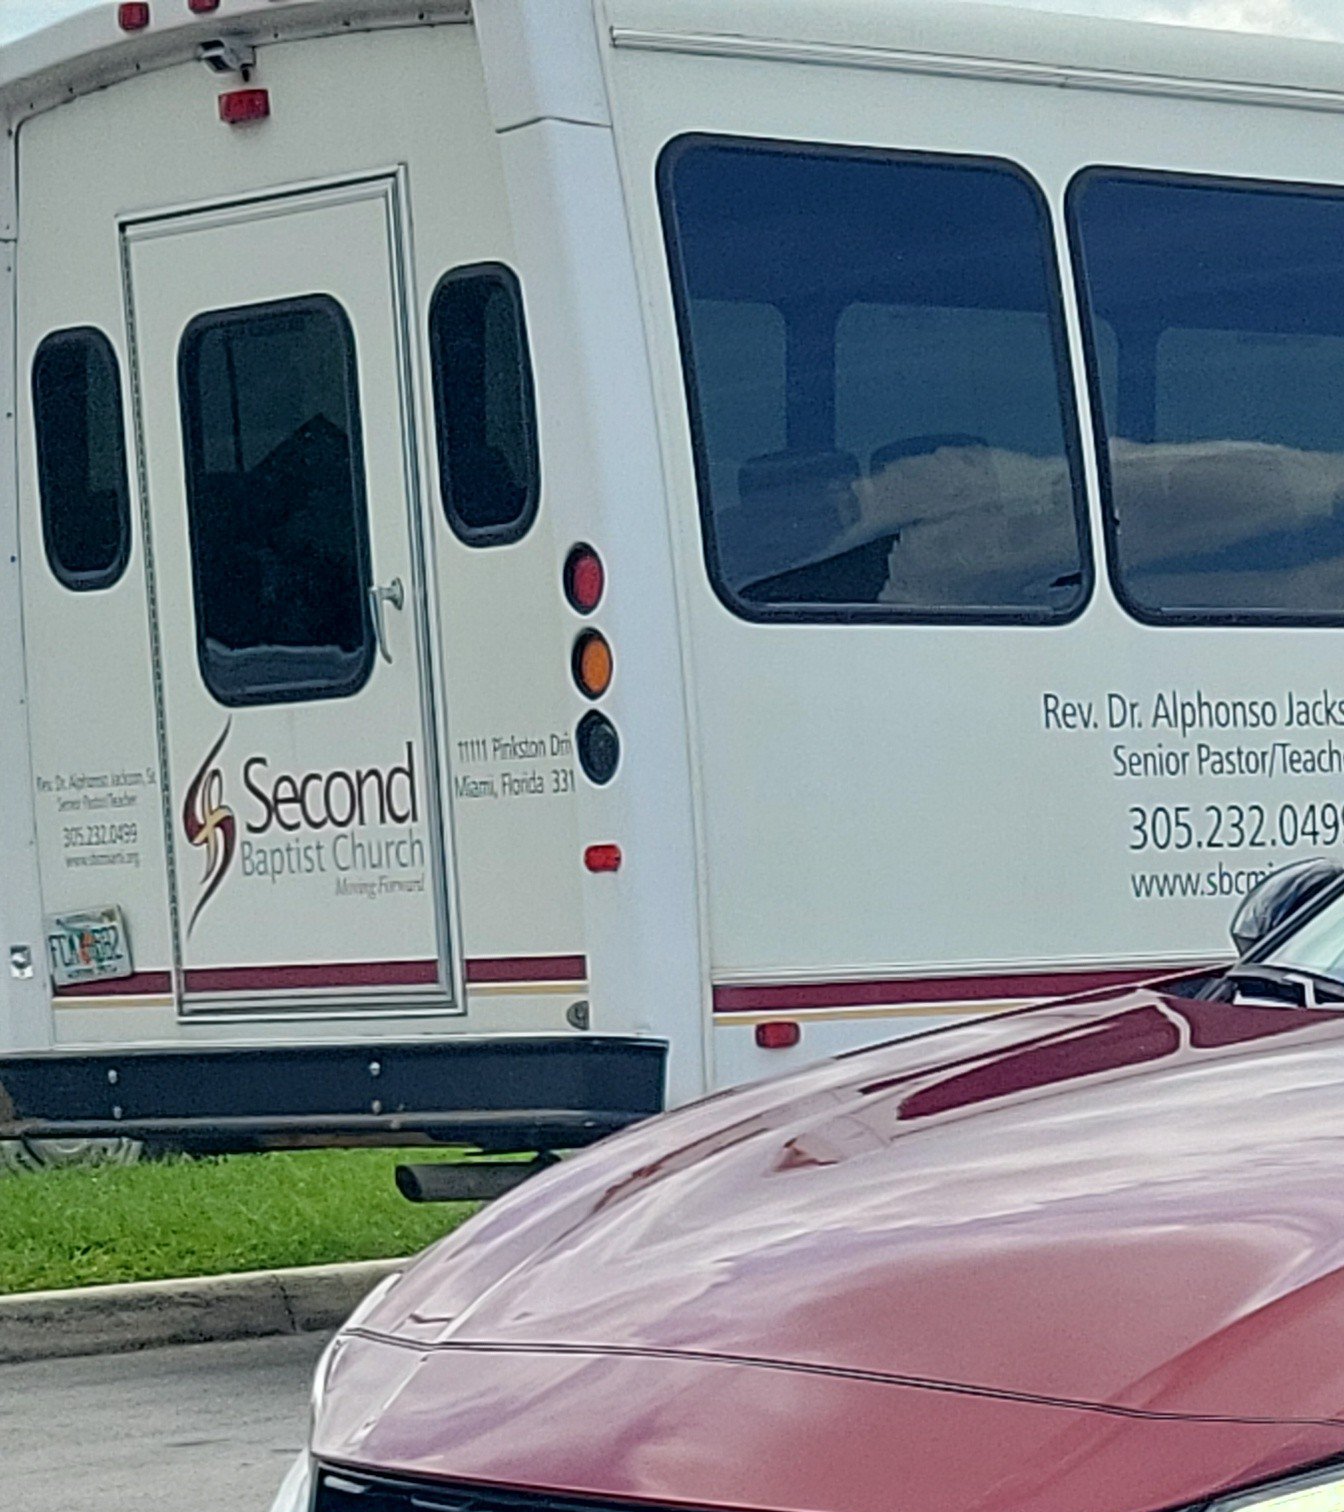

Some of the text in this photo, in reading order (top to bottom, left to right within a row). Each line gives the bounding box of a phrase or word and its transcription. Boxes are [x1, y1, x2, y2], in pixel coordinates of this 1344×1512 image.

[1043, 693, 1098, 729] Rev.
[1107, 693, 1143, 729] Dr.
[1152, 690, 1277, 738] Alphonso
[550, 731, 573, 757] Dri
[1113, 743, 1190, 777] Senior
[243, 741, 418, 834] Second
[551, 768, 576, 793] 331
[241, 829, 425, 884] Baptist Church
